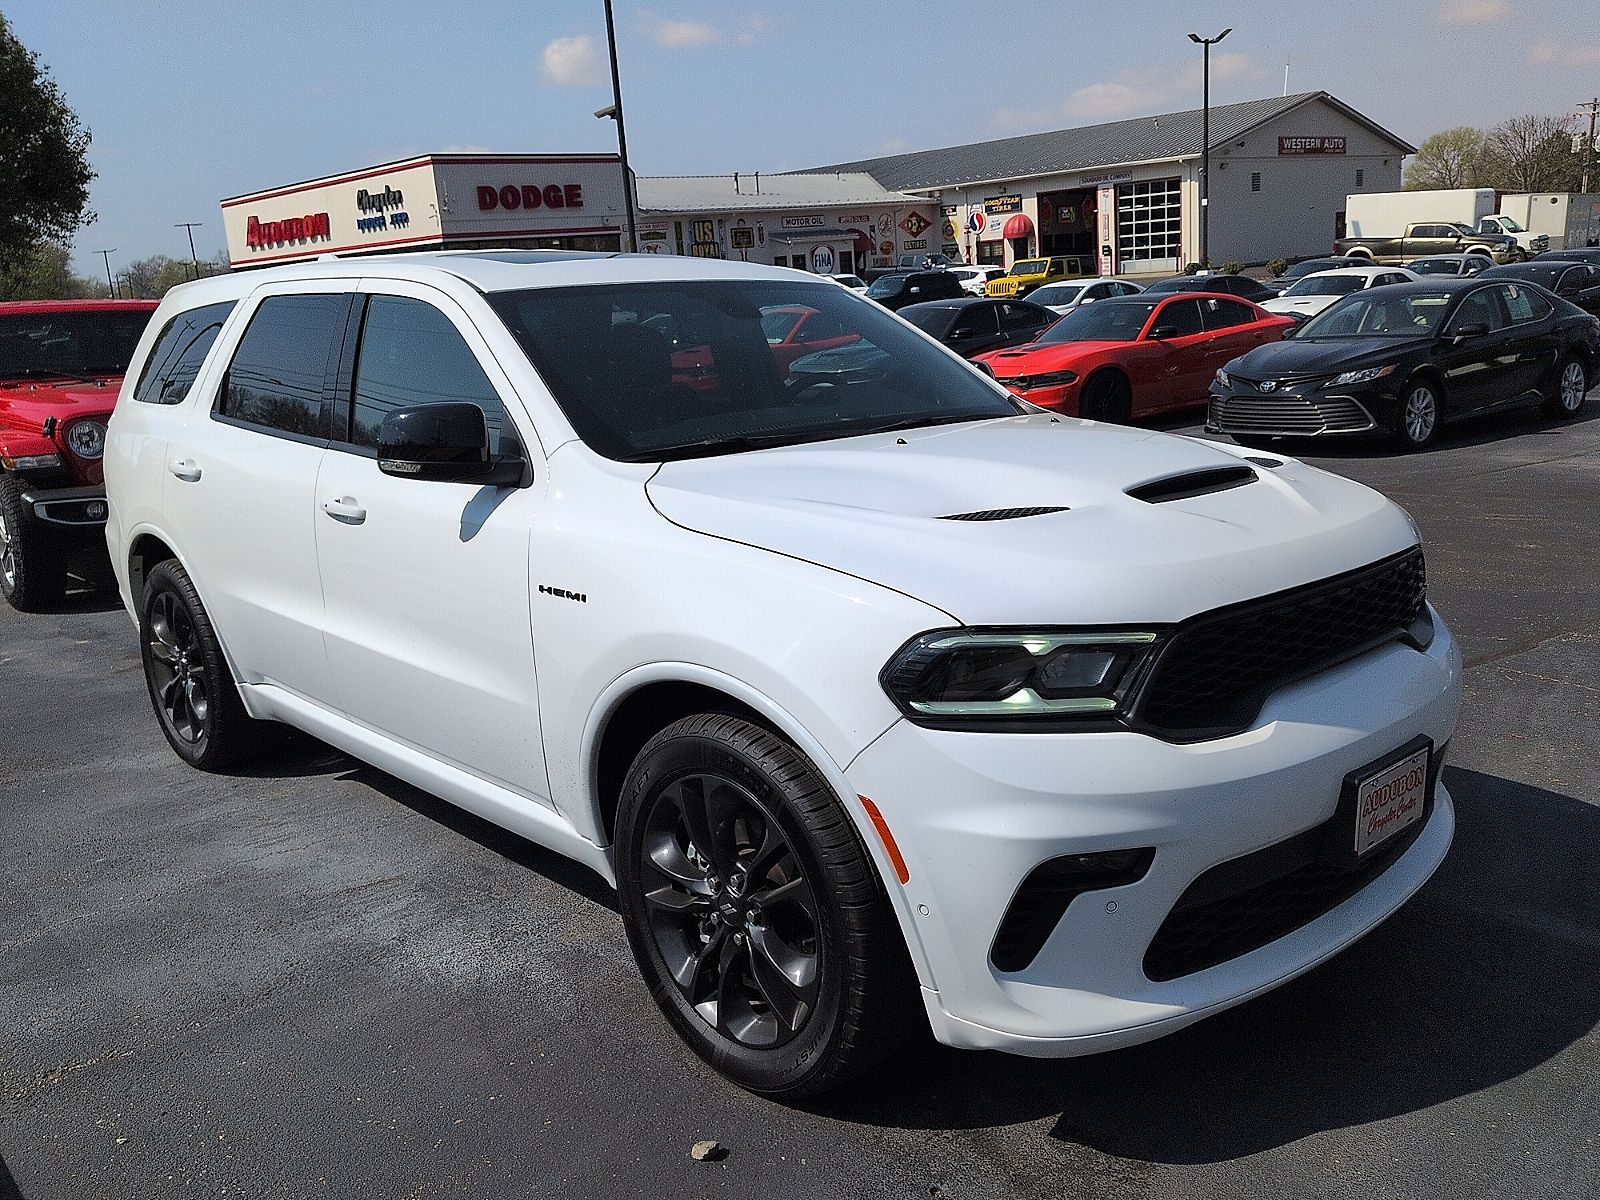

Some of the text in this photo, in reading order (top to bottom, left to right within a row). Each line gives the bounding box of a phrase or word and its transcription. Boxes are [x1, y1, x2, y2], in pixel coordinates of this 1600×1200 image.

[1283, 138, 1344, 149] WESTERN AUTO
[357, 185, 404, 212] Chrysler
[477, 184, 584, 210] DODGE
[984, 196, 1020, 207] GOODYEAR
[992, 204, 1012, 212] TIRES
[786, 216, 823, 226] MOTOR OIL
[815, 253, 832, 267] FINA
[538, 584, 587, 603] HEMI
[1362, 764, 1425, 818] AUDUBON
